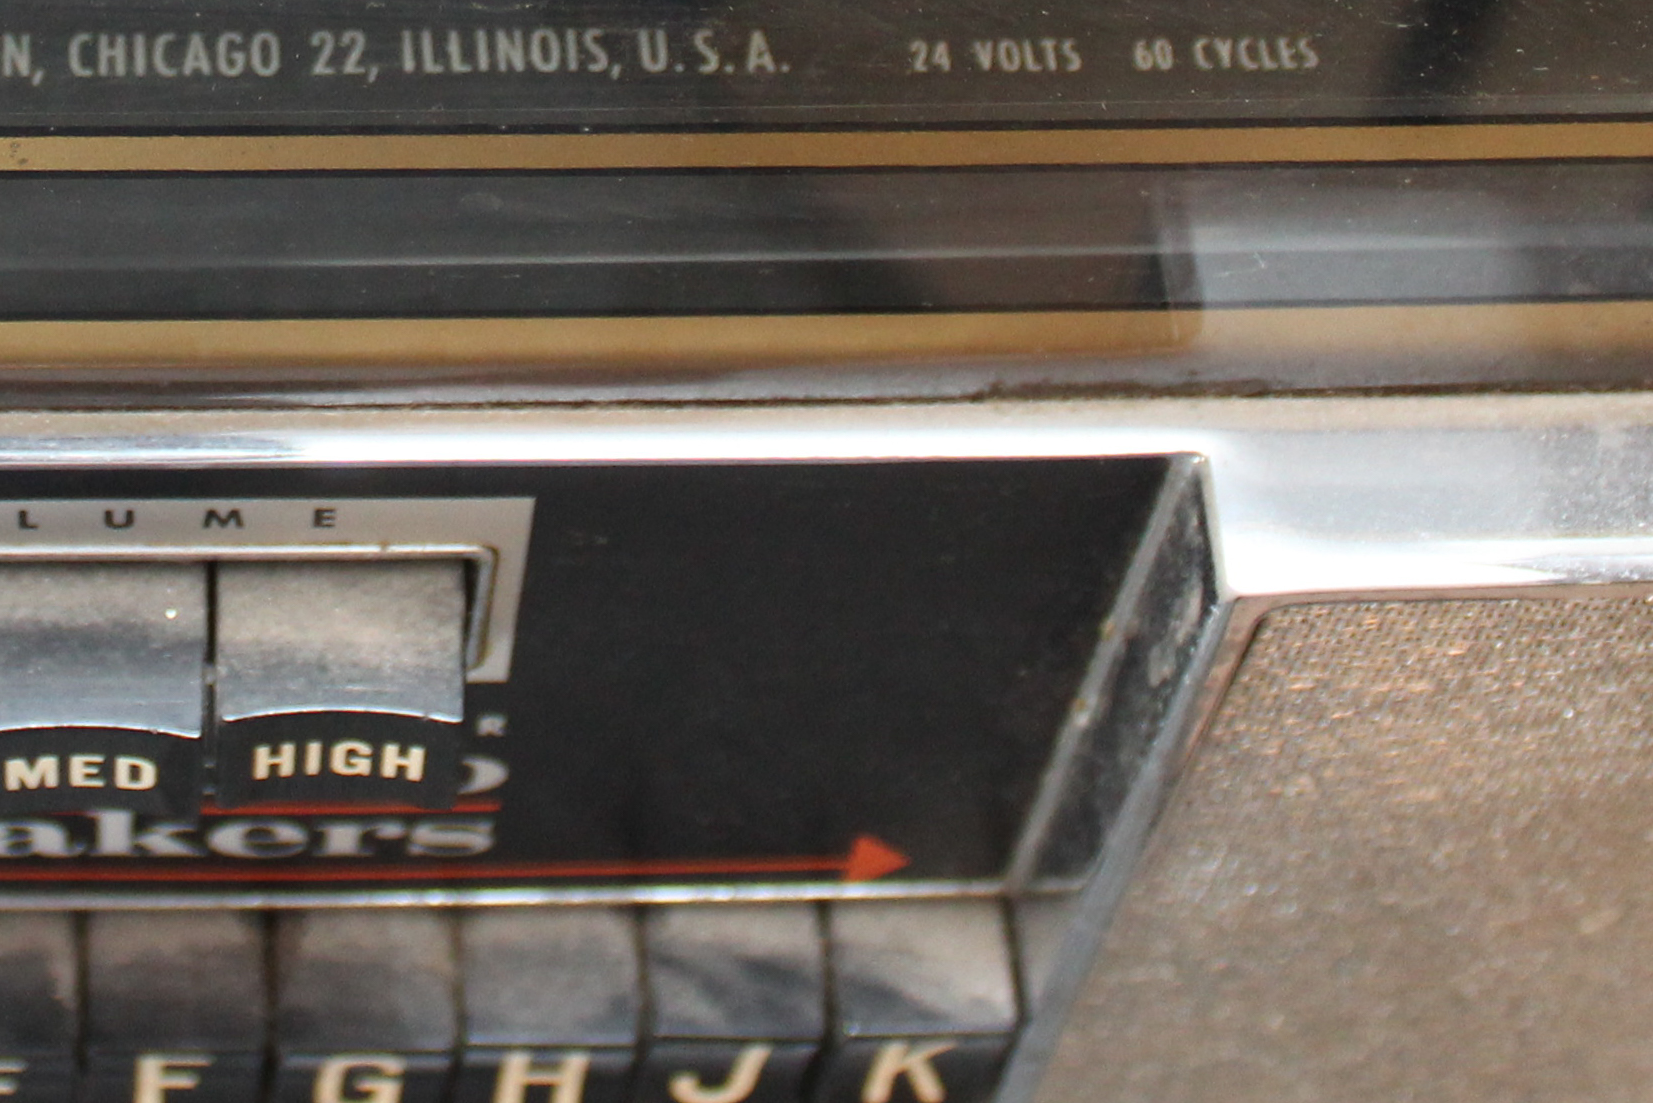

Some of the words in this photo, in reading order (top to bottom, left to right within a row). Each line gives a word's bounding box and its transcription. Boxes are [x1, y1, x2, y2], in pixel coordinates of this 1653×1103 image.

[67, 30, 282, 78] CHICAGO
[308, 30, 379, 83] 22,
[400, 28, 623, 80] ILLINOIS,
[909, 38, 952, 74] 24
[970, 37, 1083, 74] VOLTS
[1131, 37, 1175, 72] 60
[1193, 35, 1321, 72] CYCLES
[2, 753, 160, 793] MED
[251, 739, 427, 783] HIGH
[313, 1053, 407, 1103] G
[494, 1050, 591, 1103] H
[668, 1044, 773, 1103] J
[861, 1040, 958, 1103] K
